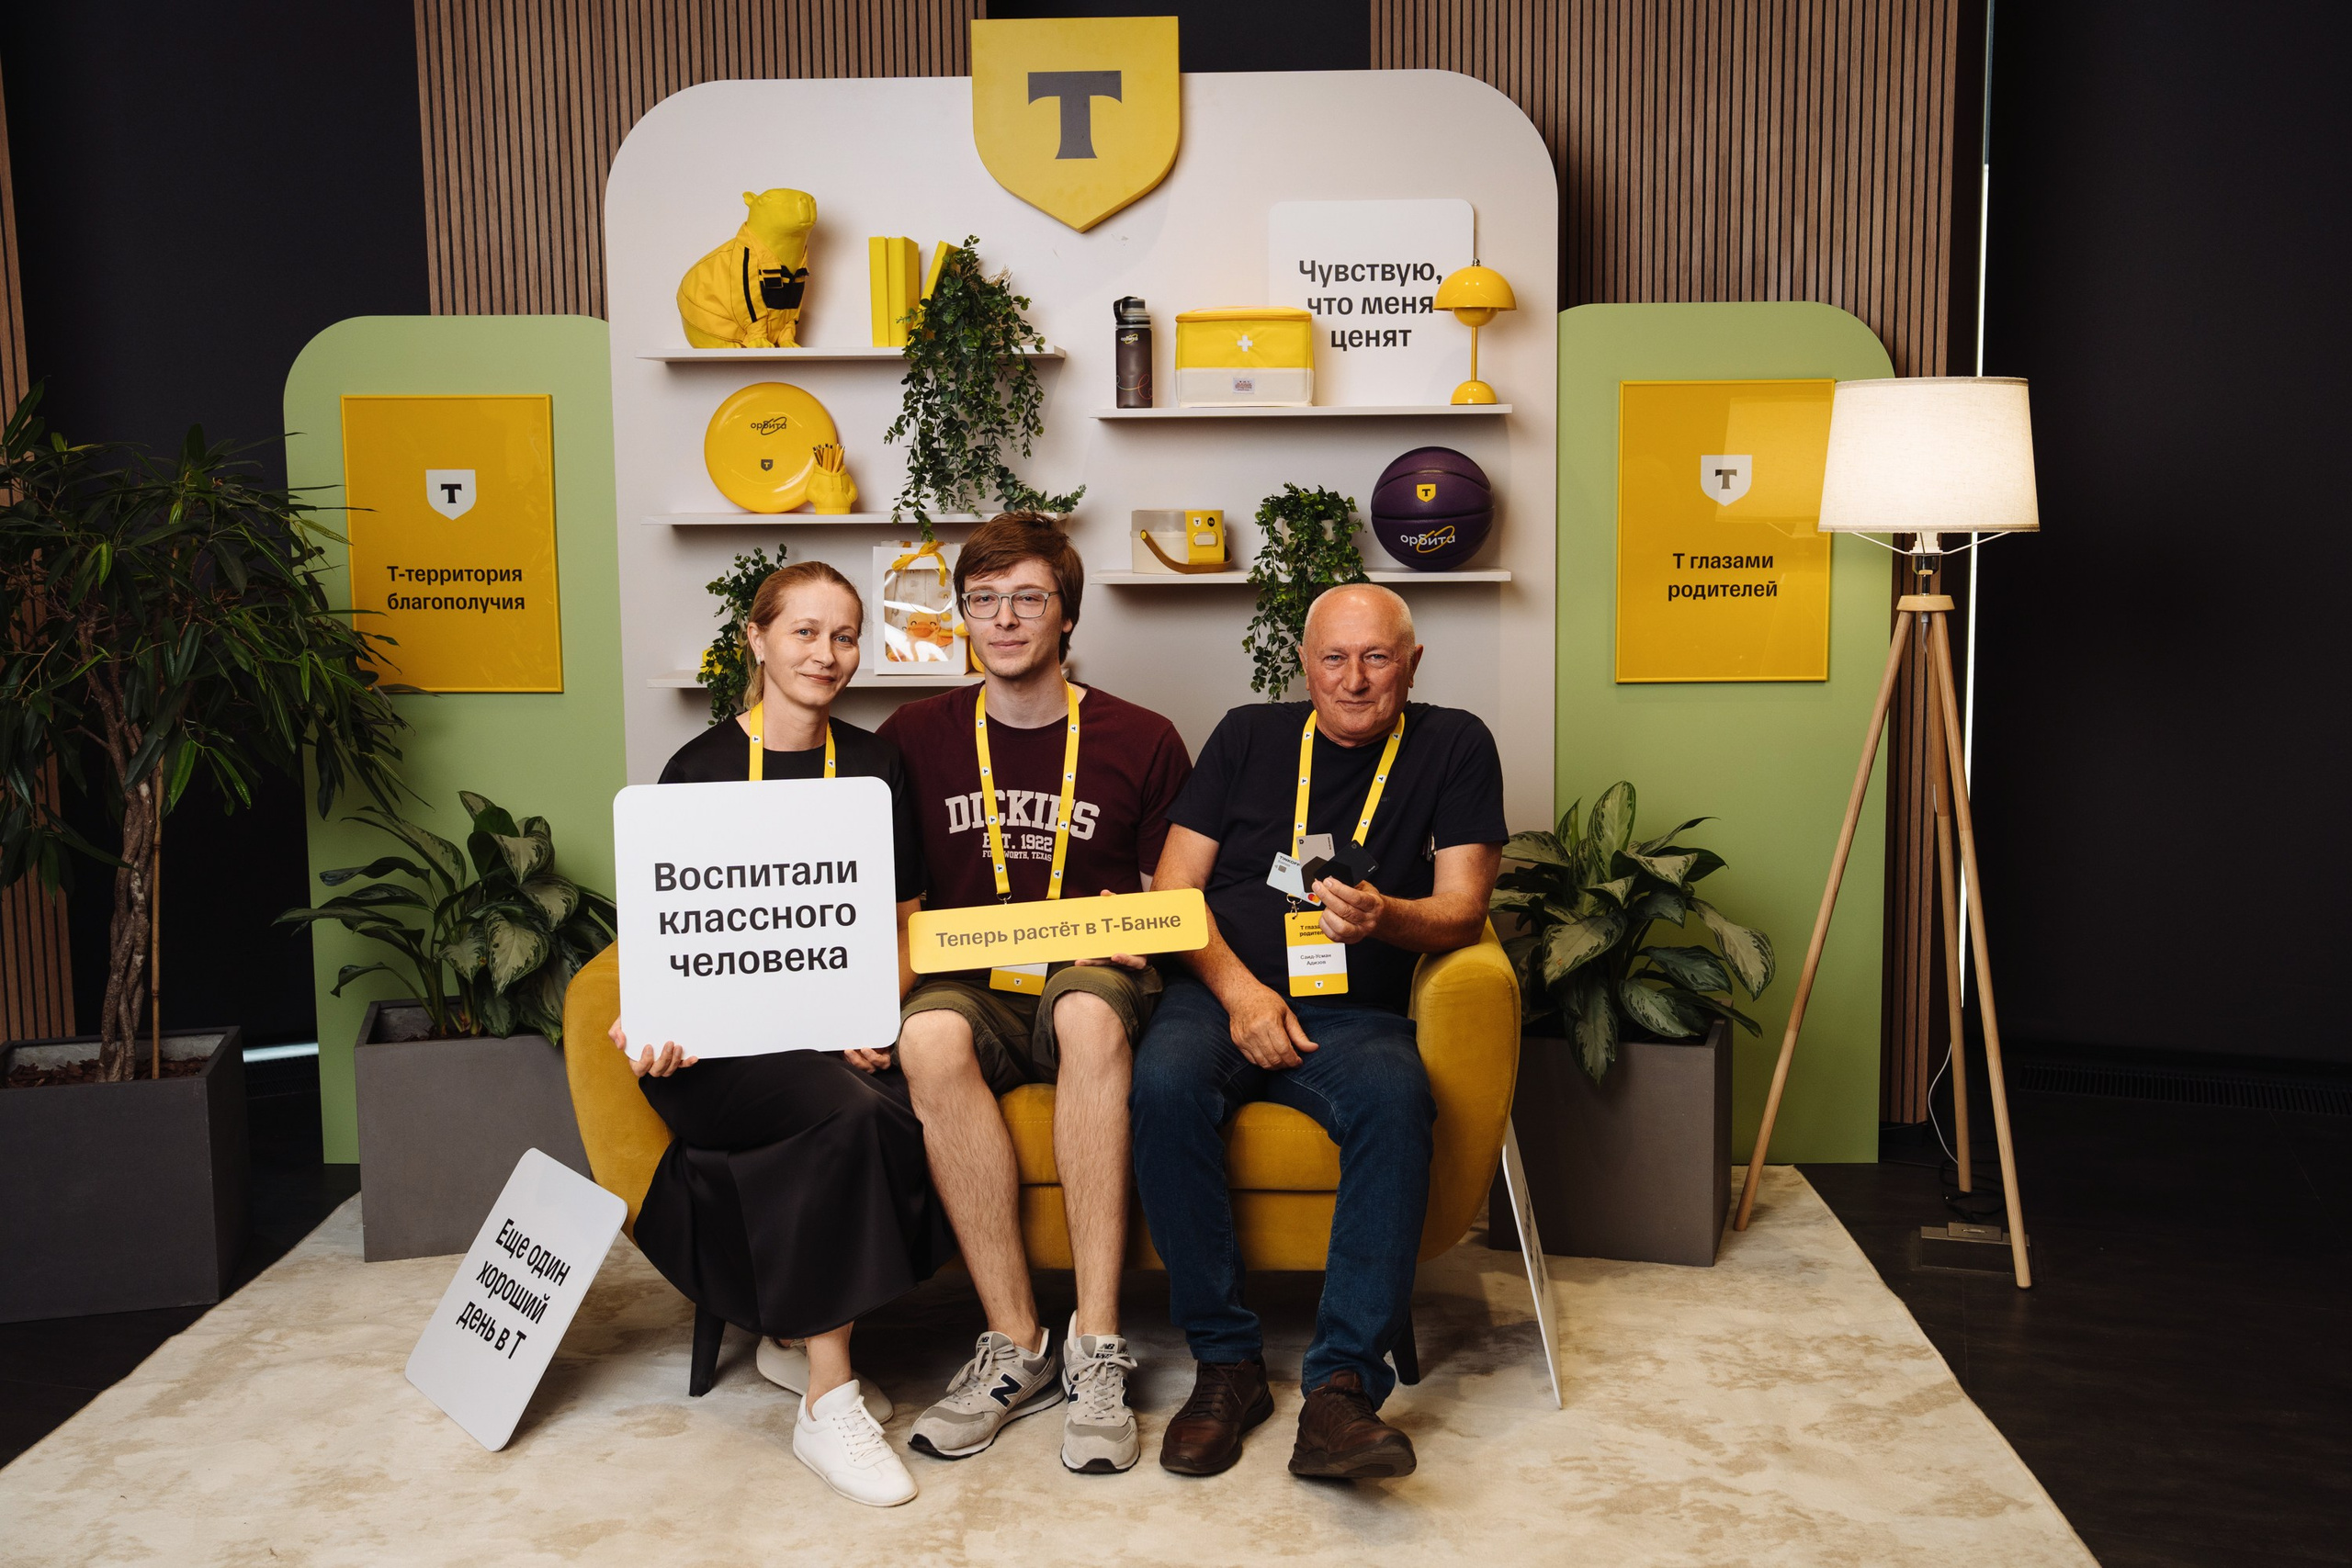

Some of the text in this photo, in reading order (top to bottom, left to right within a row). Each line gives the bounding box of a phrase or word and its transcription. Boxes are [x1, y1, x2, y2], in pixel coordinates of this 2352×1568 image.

[1299, 260, 1442, 288] Чувствую,
[1307, 296, 1434, 315] что меня
[1331, 329, 1412, 351] ценят
[751, 419, 787, 432] орбита
[1400, 532, 1455, 547] орбита
[1672, 553, 1774, 570] Т глазами
[386, 566, 523, 585] Т-территория
[1668, 581, 1778, 602] родителей
[387, 592, 526, 614] благополучия
[982, 832, 1053, 852] ET. 1922
[1032, 852, 1052, 862] TEXAS
[654, 860, 857, 892] Воспитали
[659, 903, 856, 935] классного
[935, 915, 1182, 948] Теперь растёт в Т-Банке
[670, 946, 848, 977] человека
[495, 1218, 571, 1287] Еще один
[476, 1260, 550, 1325] хороший
[456, 1301, 527, 1359] день в Т
